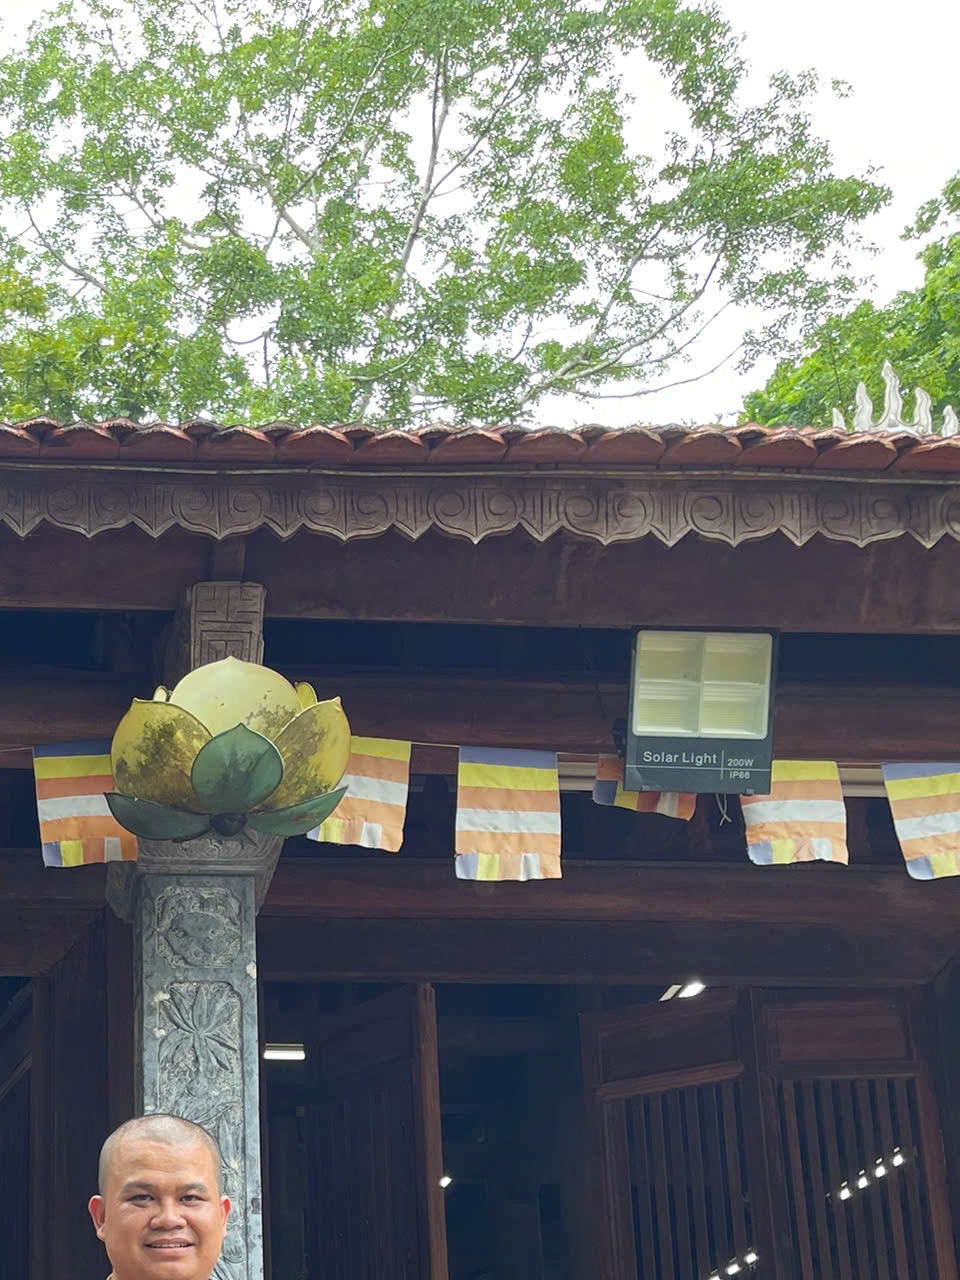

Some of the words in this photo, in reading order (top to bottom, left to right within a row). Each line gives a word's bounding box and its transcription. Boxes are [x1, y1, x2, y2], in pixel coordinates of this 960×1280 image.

[643, 751, 679, 763] Solar
[682, 752, 717, 766] Light
[727, 758, 754, 767] 200W
